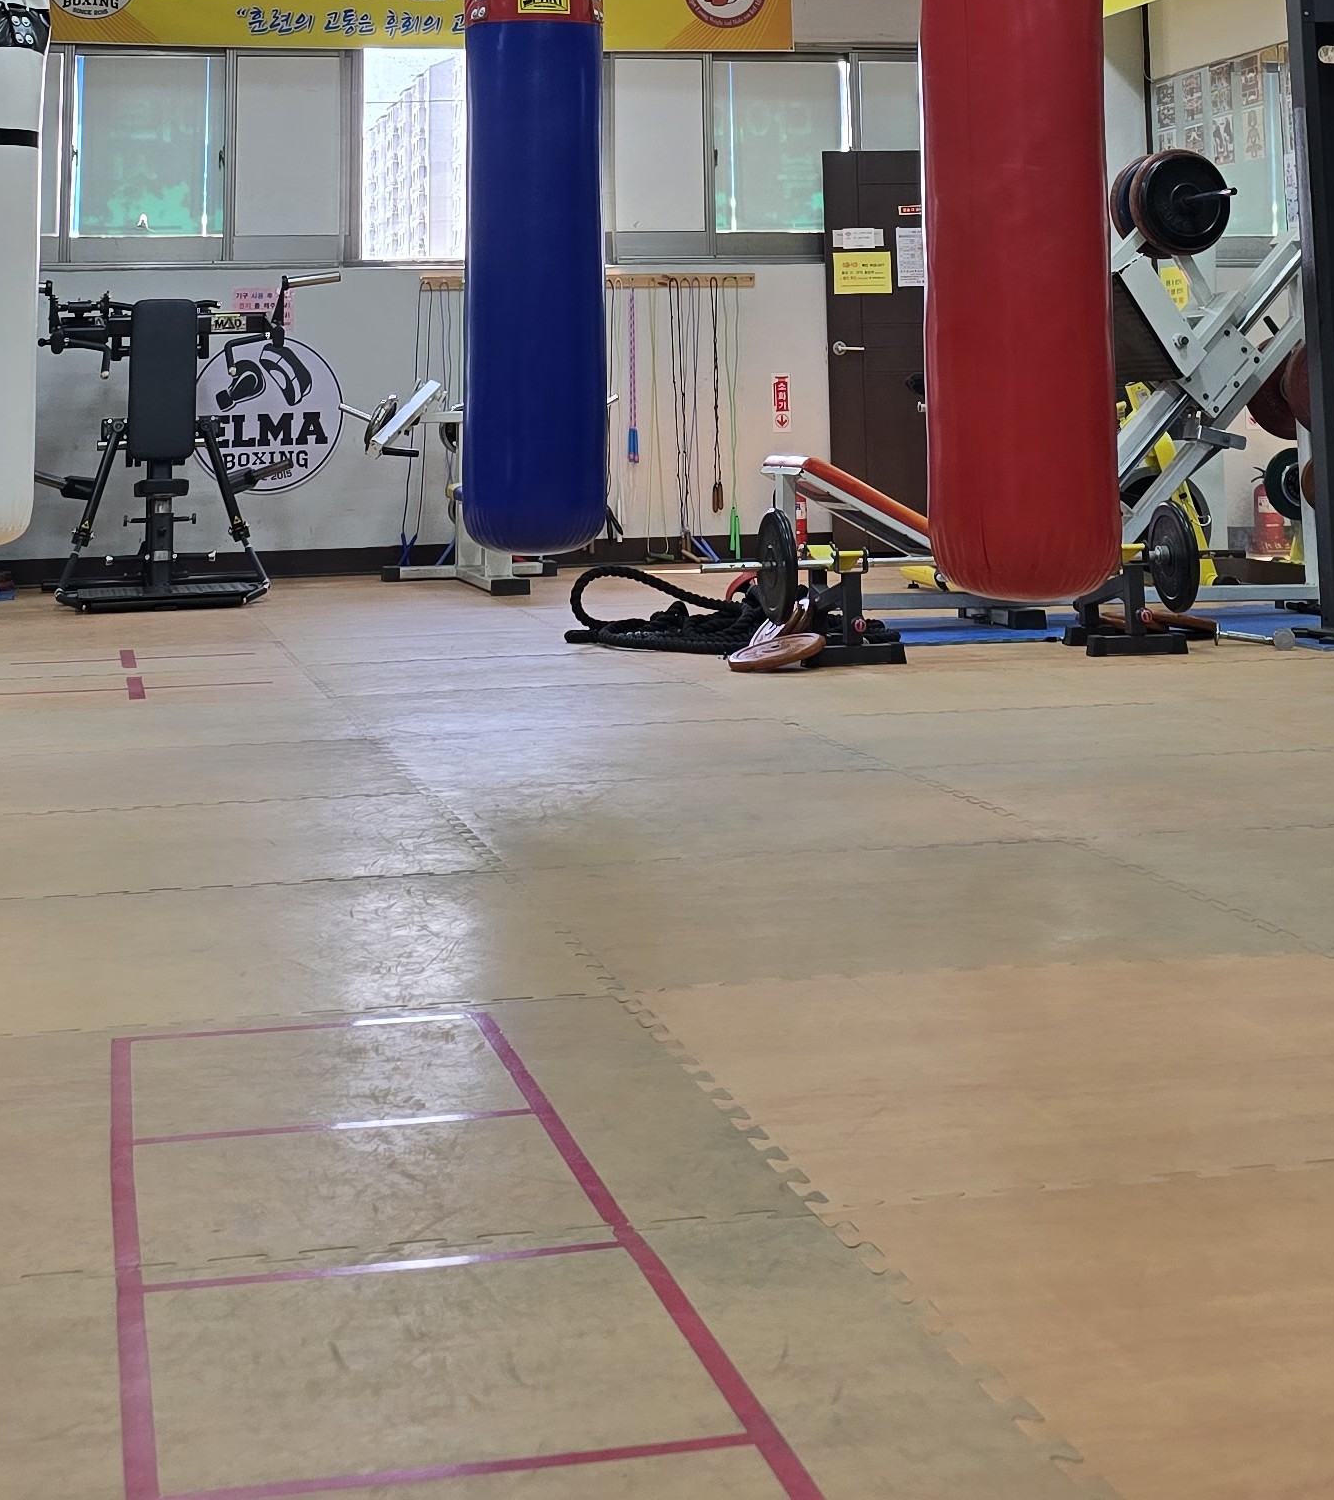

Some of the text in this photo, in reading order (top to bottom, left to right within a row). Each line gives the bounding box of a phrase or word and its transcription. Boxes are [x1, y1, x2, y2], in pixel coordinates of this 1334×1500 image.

[323, 7, 376, 36] 고통은
[384, 8, 443, 39] 후회의
[777, 382, 787, 410] 소화기
[218, 411, 329, 449] ELMA
[222, 449, 309, 470] BOXING
[270, 469, 293, 481] 2015
